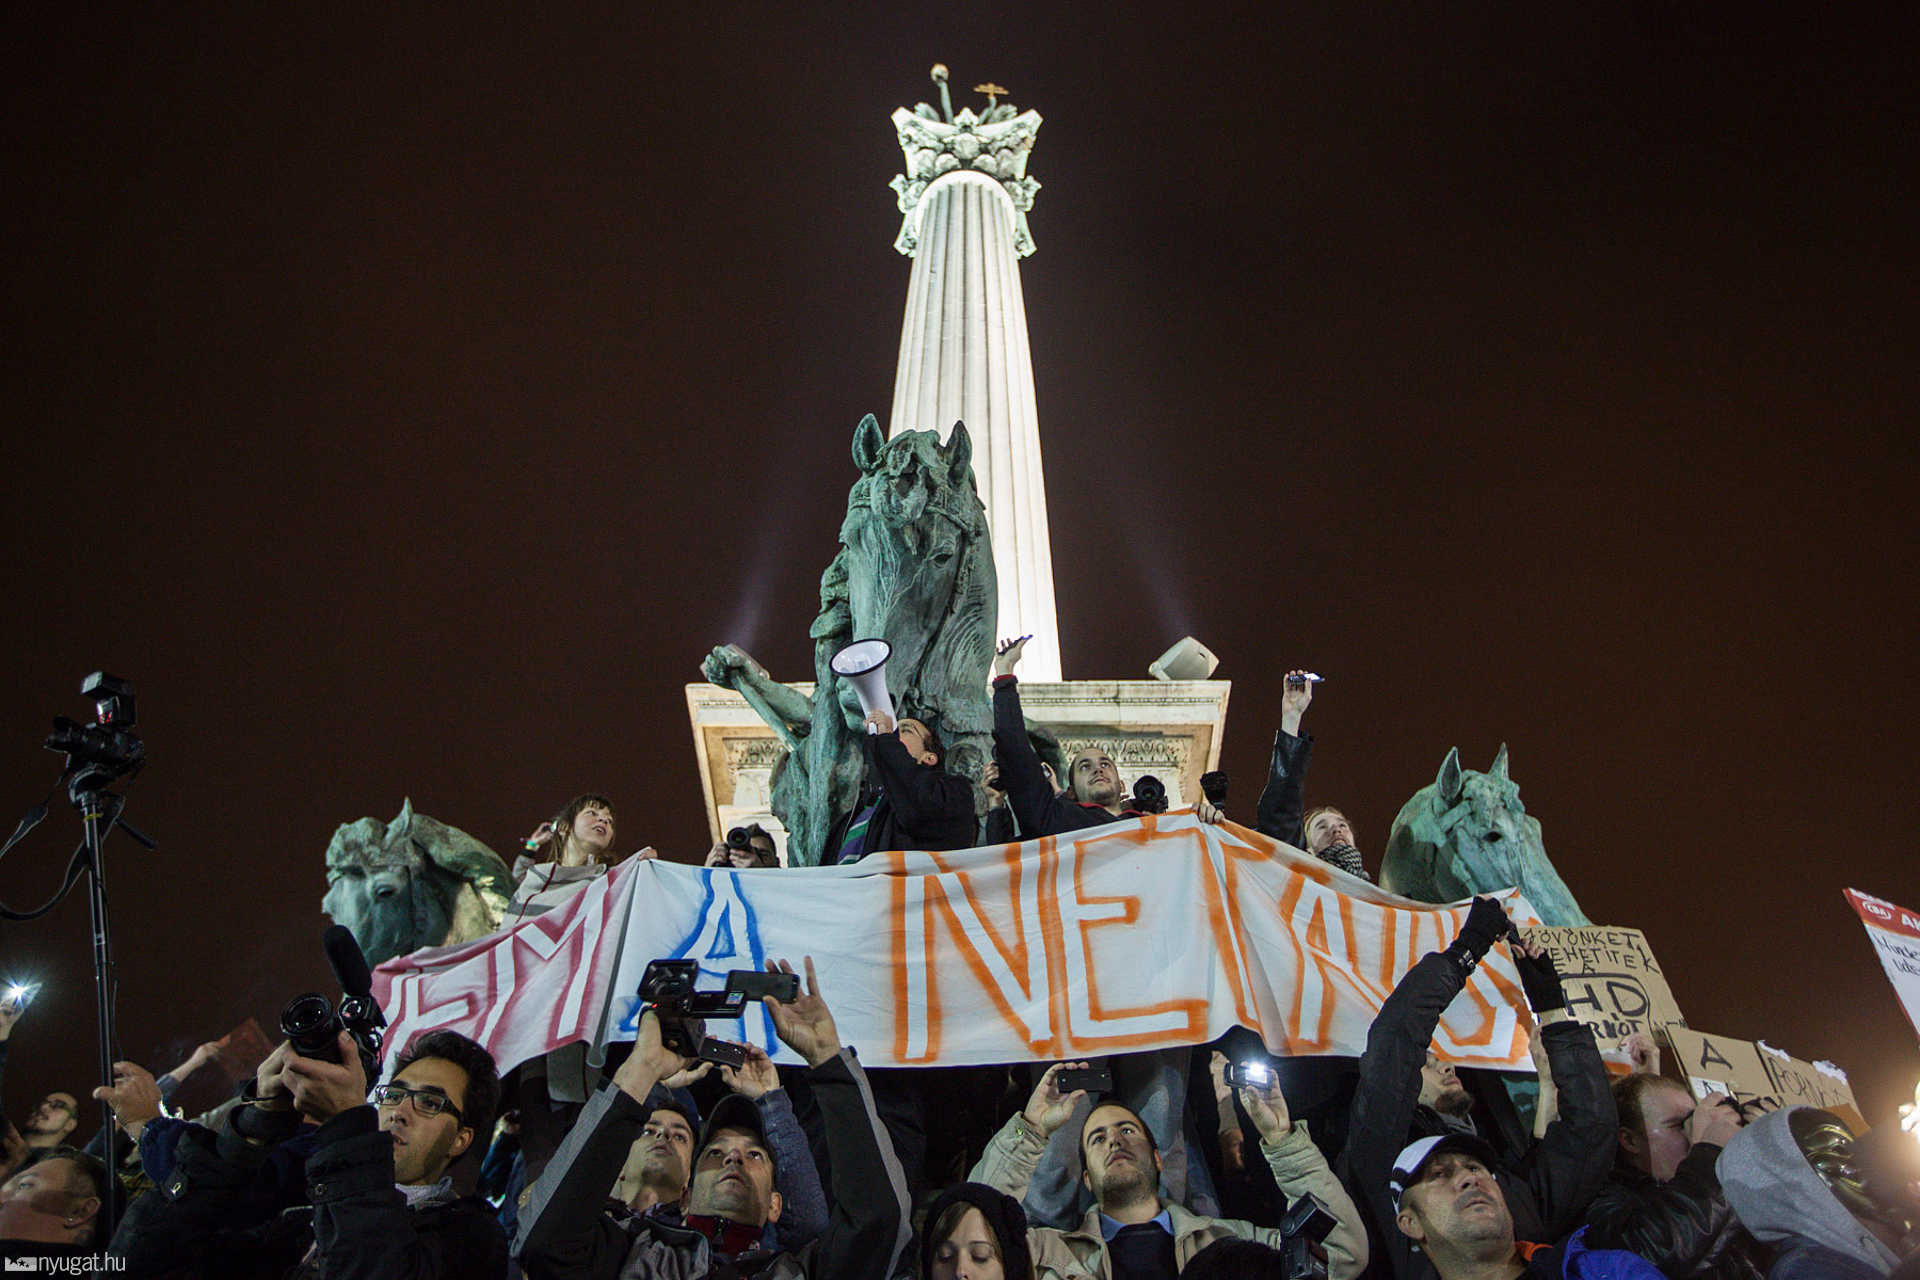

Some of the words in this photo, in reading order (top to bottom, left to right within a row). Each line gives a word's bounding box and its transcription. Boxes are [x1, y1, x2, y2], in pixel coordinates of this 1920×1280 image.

[617, 868, 780, 1060] A
[1563, 980, 1649, 1018] HD
[1700, 1037, 1734, 1071] A
